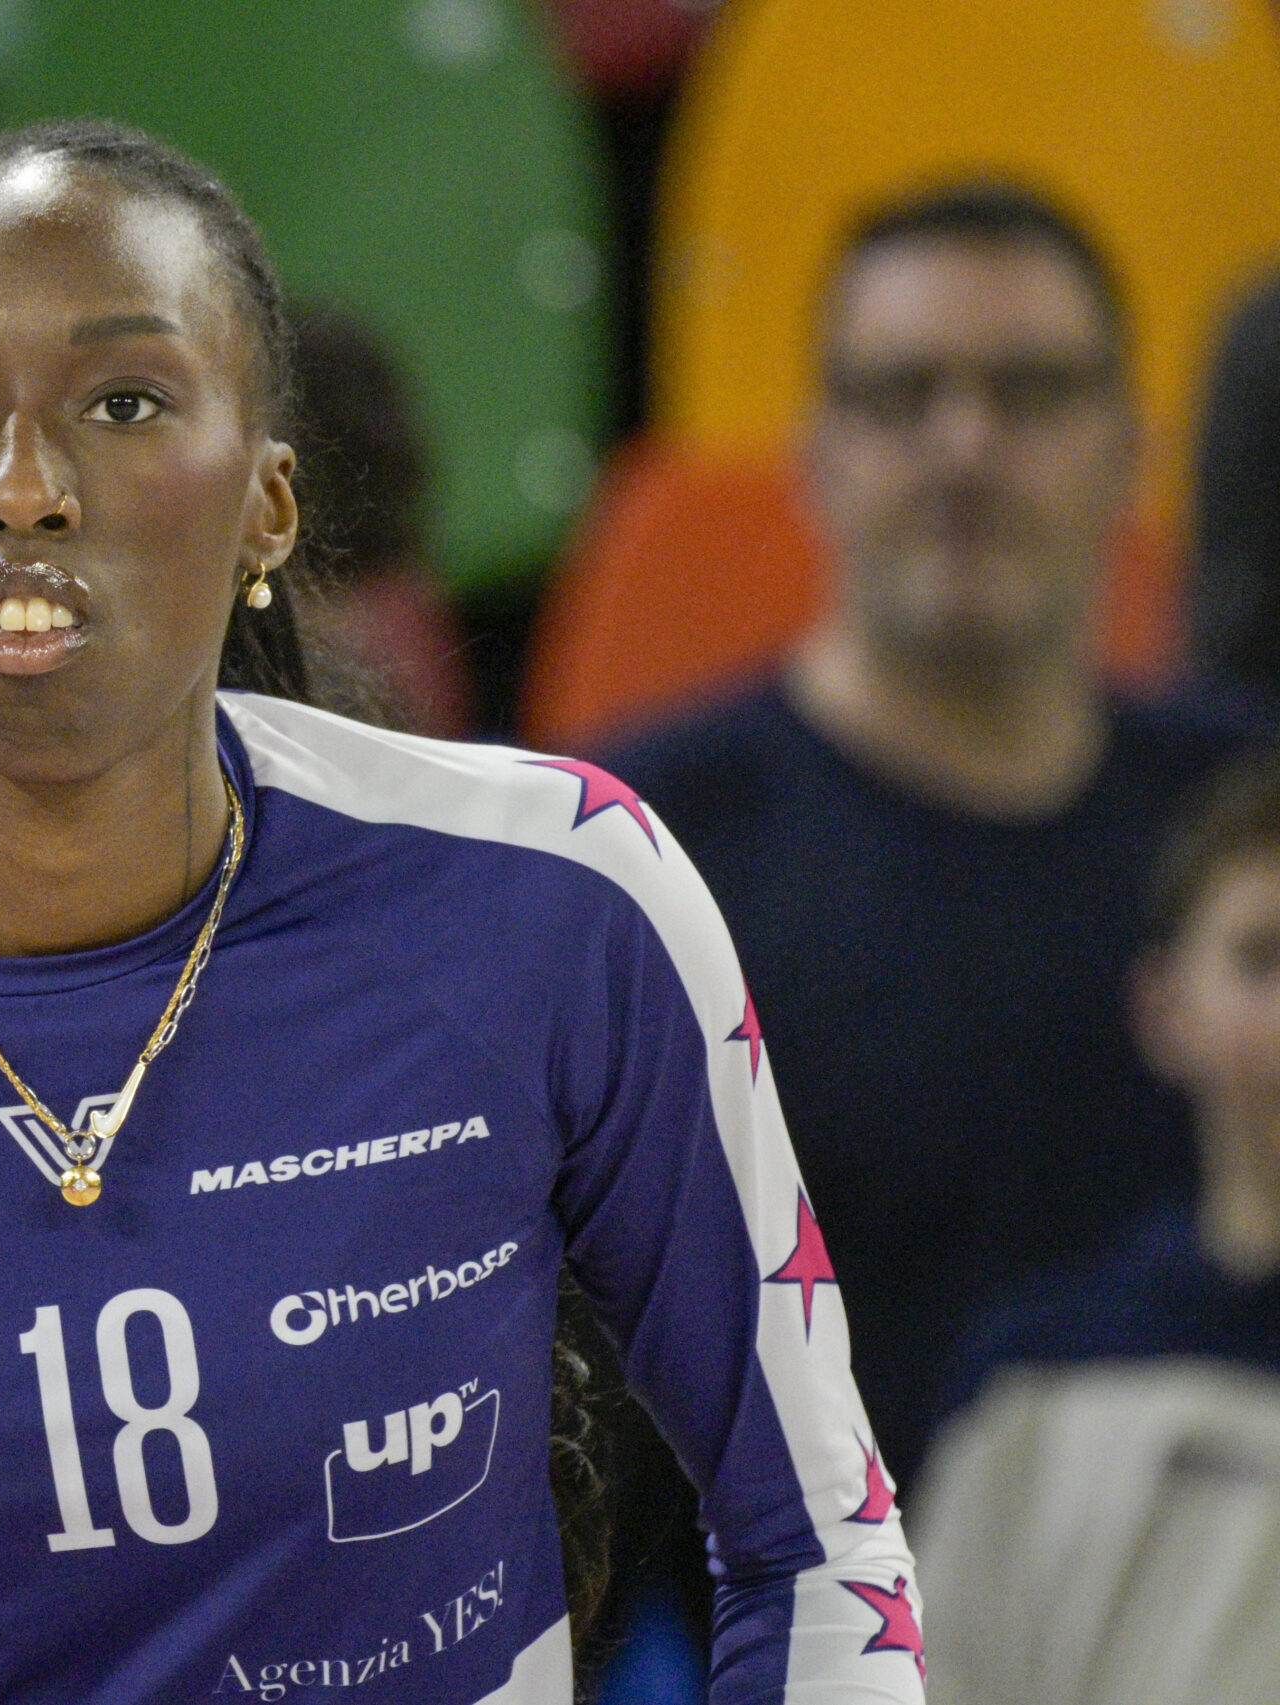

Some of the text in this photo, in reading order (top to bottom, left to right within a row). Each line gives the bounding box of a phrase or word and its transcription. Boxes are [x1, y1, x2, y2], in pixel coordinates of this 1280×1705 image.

[190, 1115, 491, 1195] MASCHERPA
[19, 1287, 219, 1553] 18
[342, 1376, 479, 1476] up TV
[213, 1560, 504, 1702] Agenzia YES!
